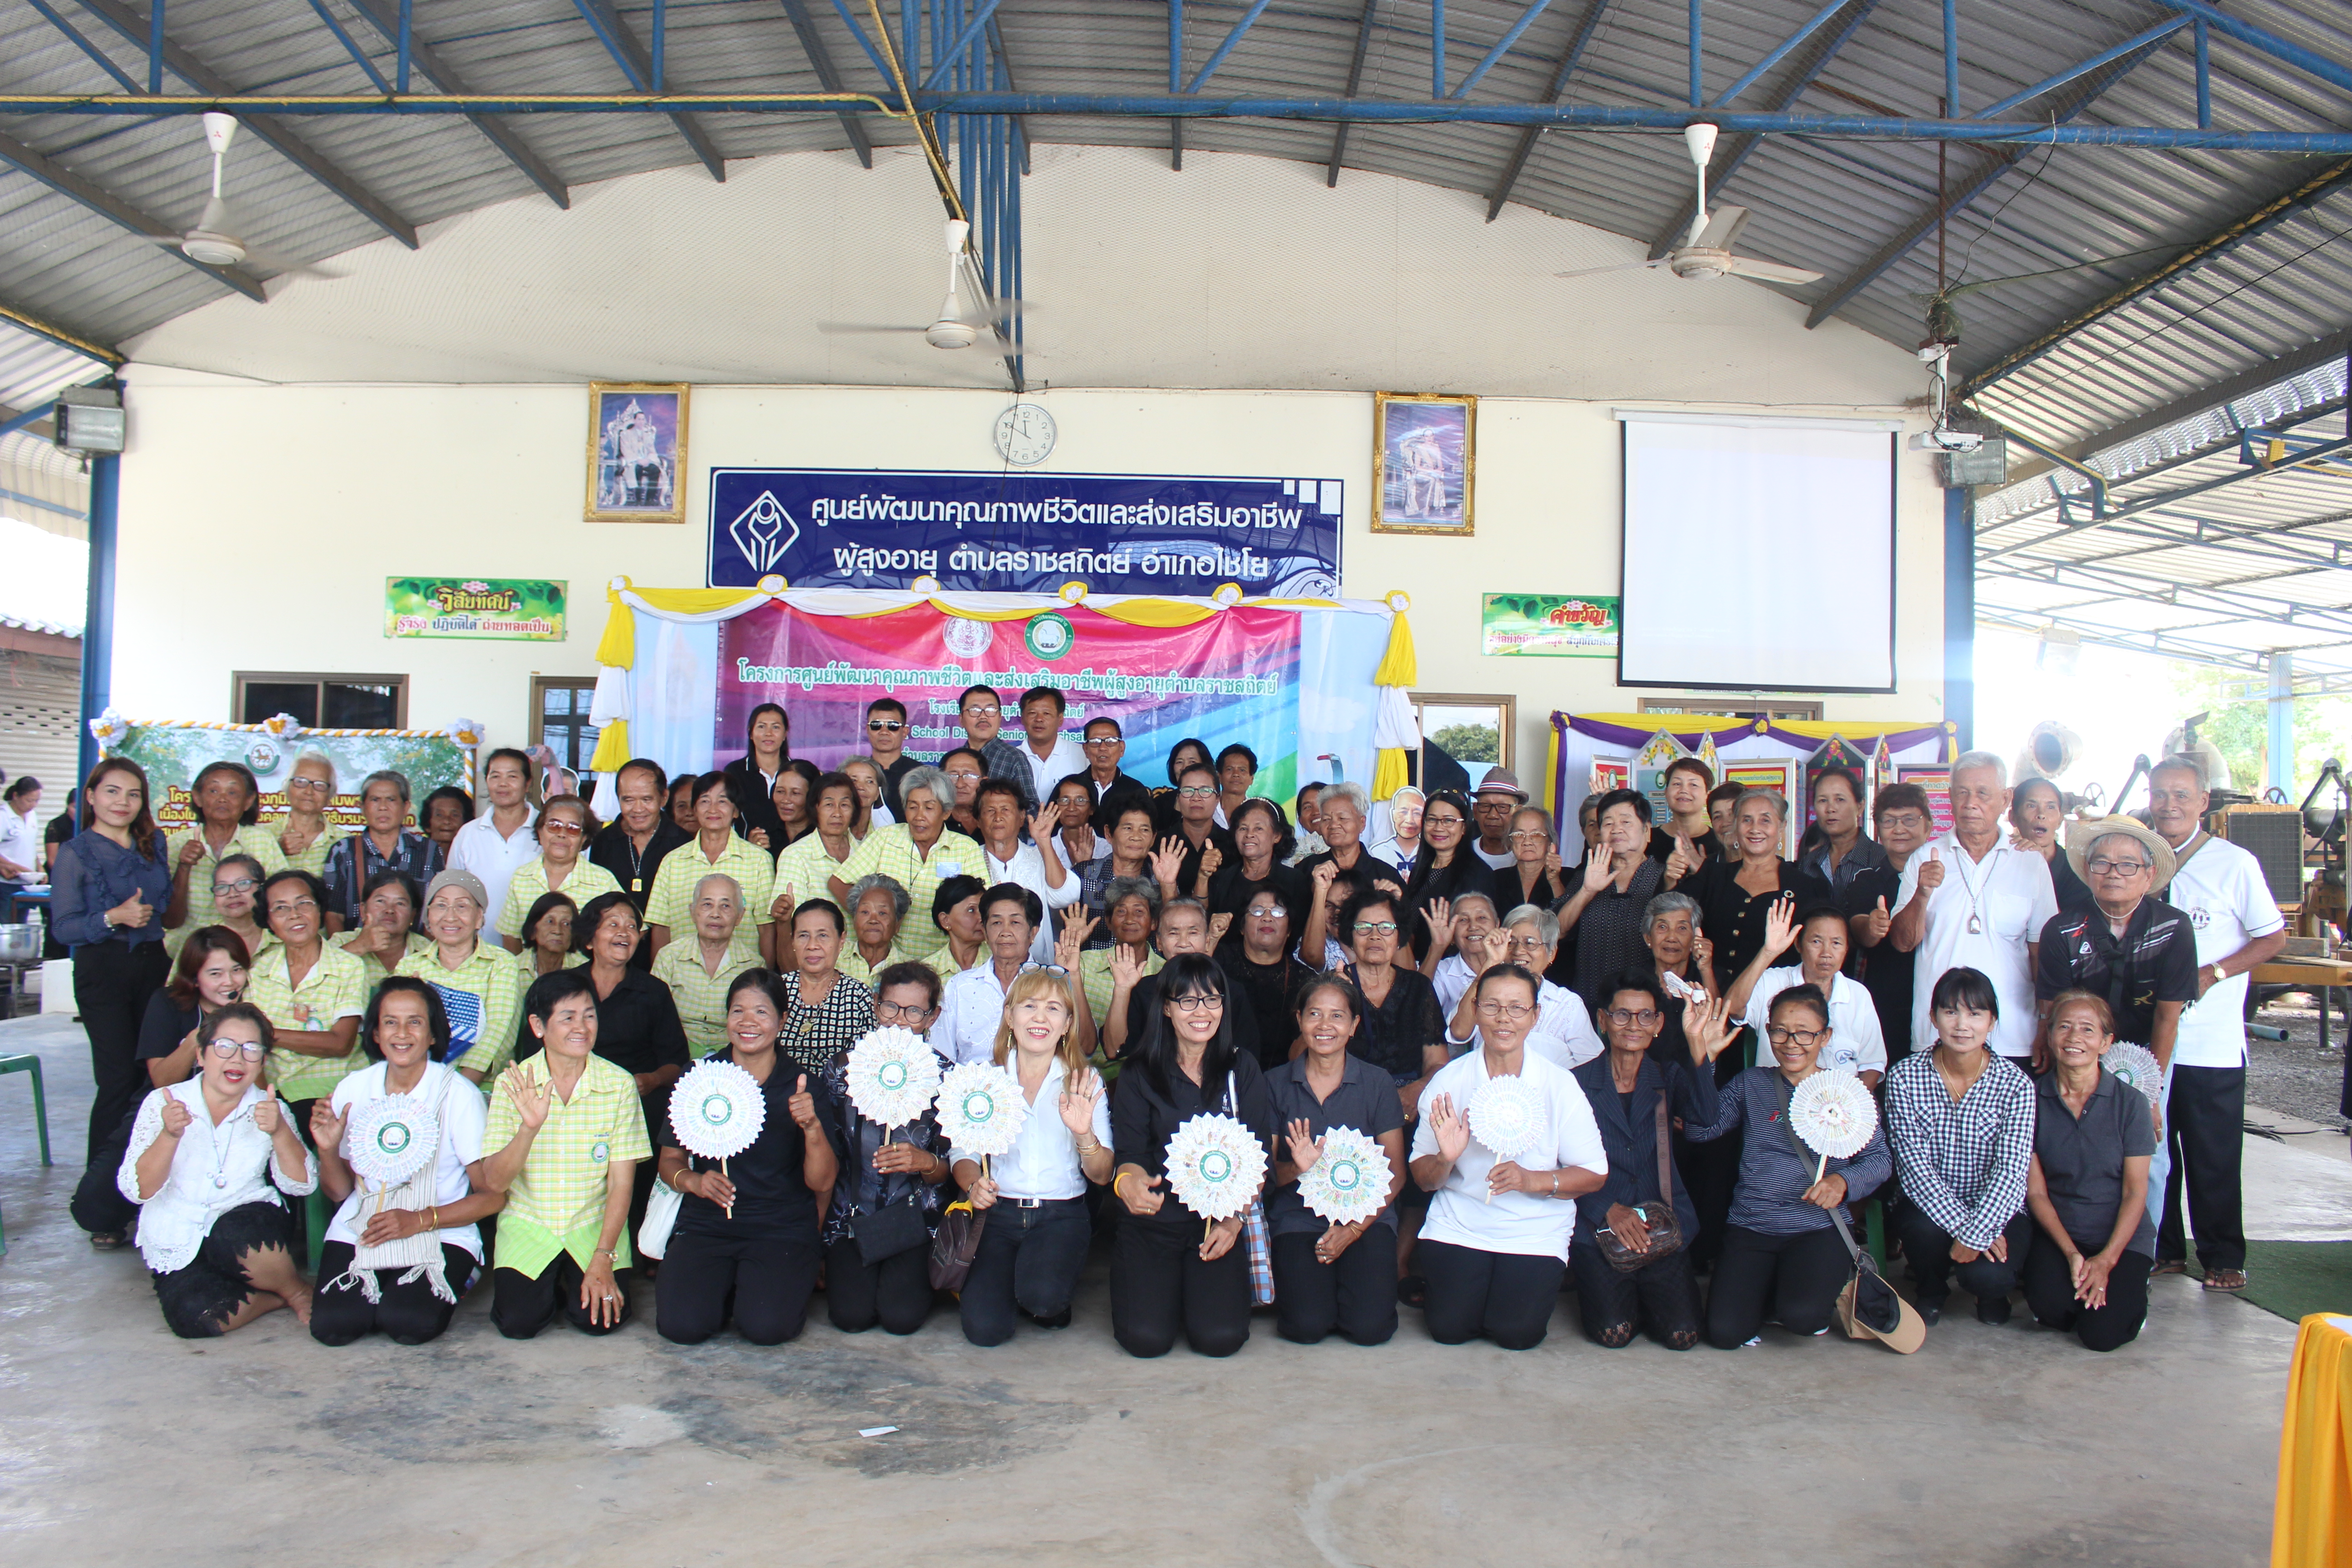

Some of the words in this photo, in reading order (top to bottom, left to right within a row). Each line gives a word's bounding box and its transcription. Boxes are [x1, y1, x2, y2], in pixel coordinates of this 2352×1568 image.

[812, 494, 1302, 529] ศูนย์พัฒนาคุณภาพชีวิตและส่งเสริมอาชีพ
[833, 542, 937, 578] ผู้สูงอายุ
[949, 544, 1132, 574] ตำบลราชสถิตย์
[1142, 547, 1268, 578] อำเภอไชโย
[432, 614, 481, 631] ปฏิบัติได้
[483, 617, 551, 633] ถ่ายทอดเป็น
[1549, 602, 1609, 627] คำขวัญ
[911, 725, 950, 738] School
